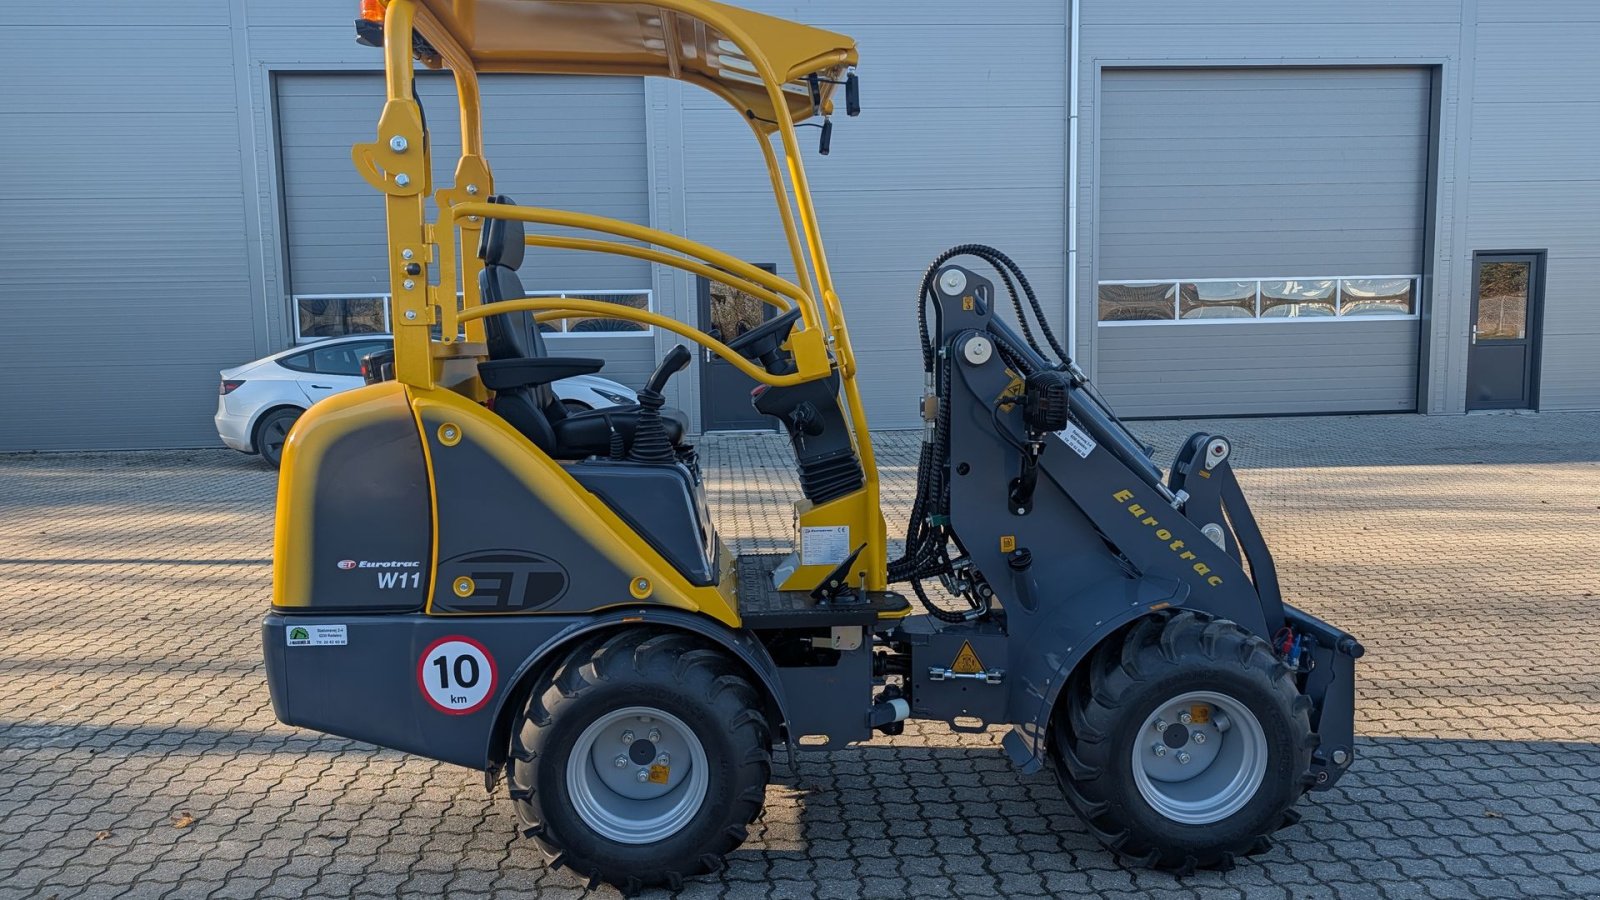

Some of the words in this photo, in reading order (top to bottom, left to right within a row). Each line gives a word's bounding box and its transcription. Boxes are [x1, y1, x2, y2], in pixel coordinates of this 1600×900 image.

[1112, 489, 1223, 587] Eurotrac
[358, 560, 420, 568] Eurotrac
[377, 572, 420, 589] W11
[433, 654, 480, 688] 10
[450, 694, 467, 704] km
